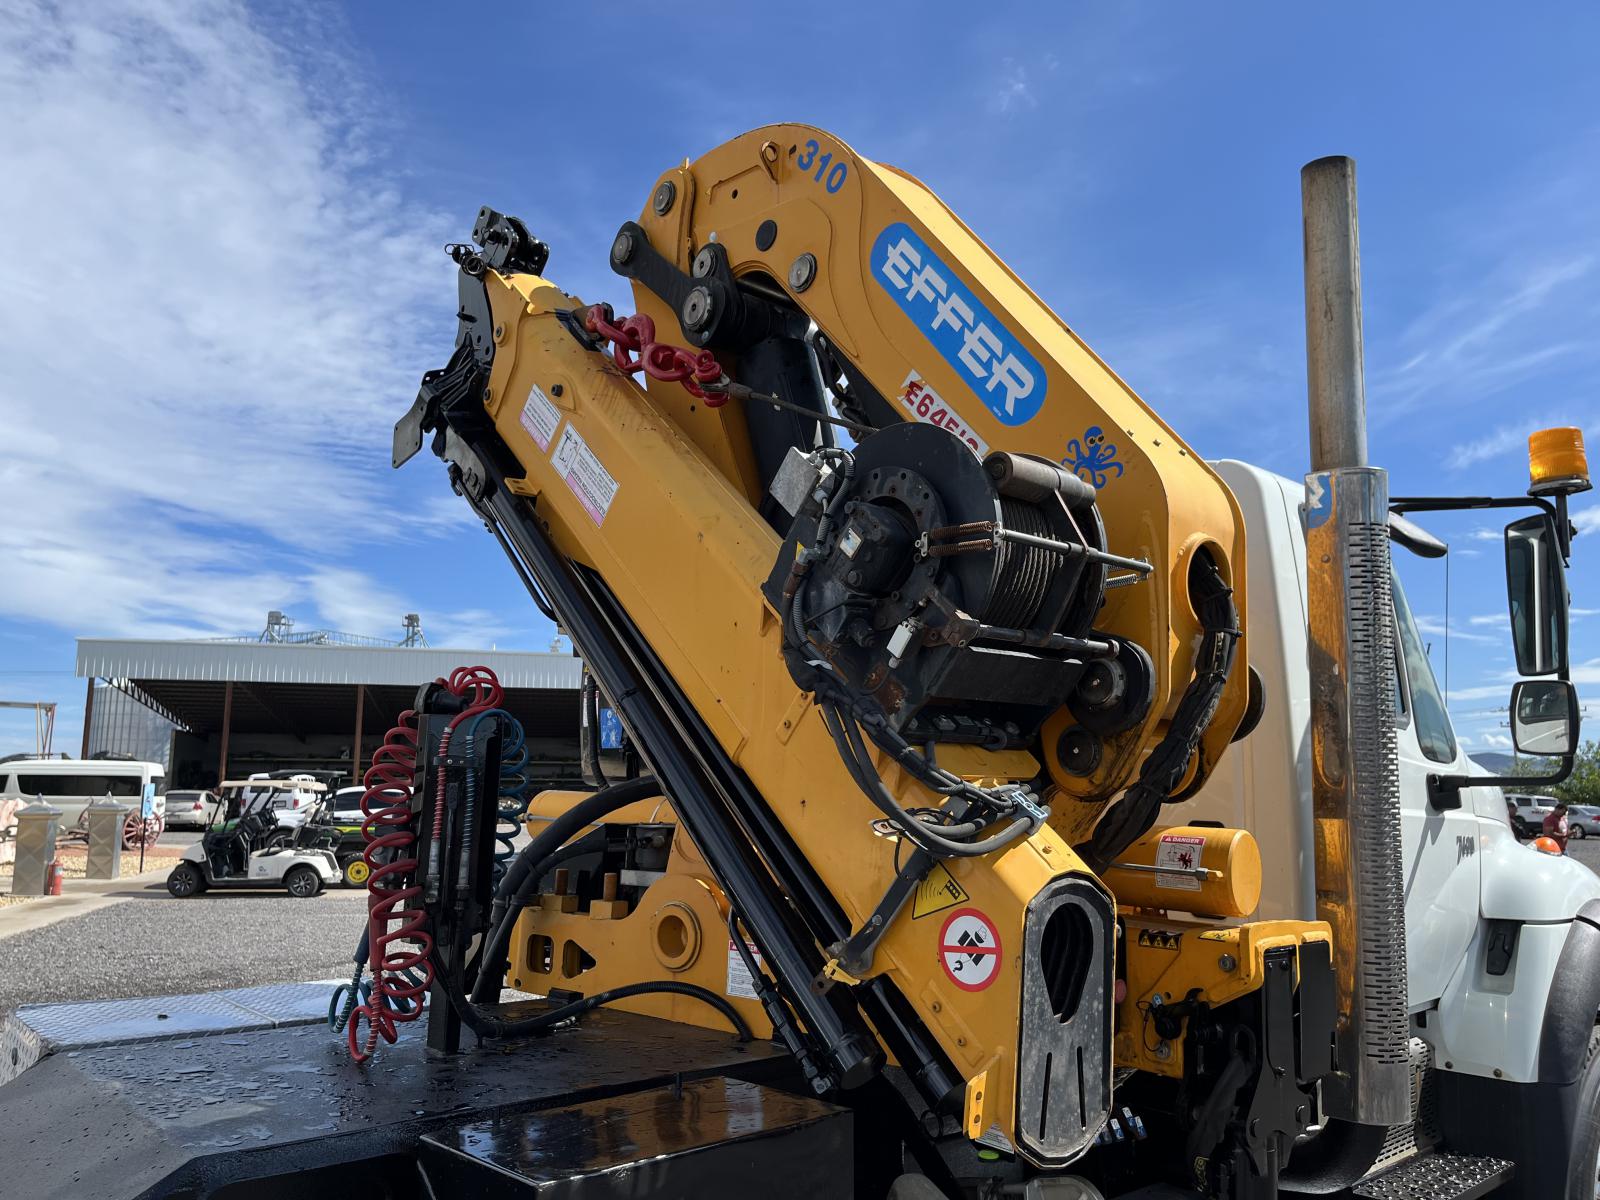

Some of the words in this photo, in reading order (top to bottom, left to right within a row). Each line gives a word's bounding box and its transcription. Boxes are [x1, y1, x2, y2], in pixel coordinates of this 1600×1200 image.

[797, 139, 847, 194] 310
[881, 237, 1035, 417] EFFER
[1172, 836, 1200, 845] DANGER
